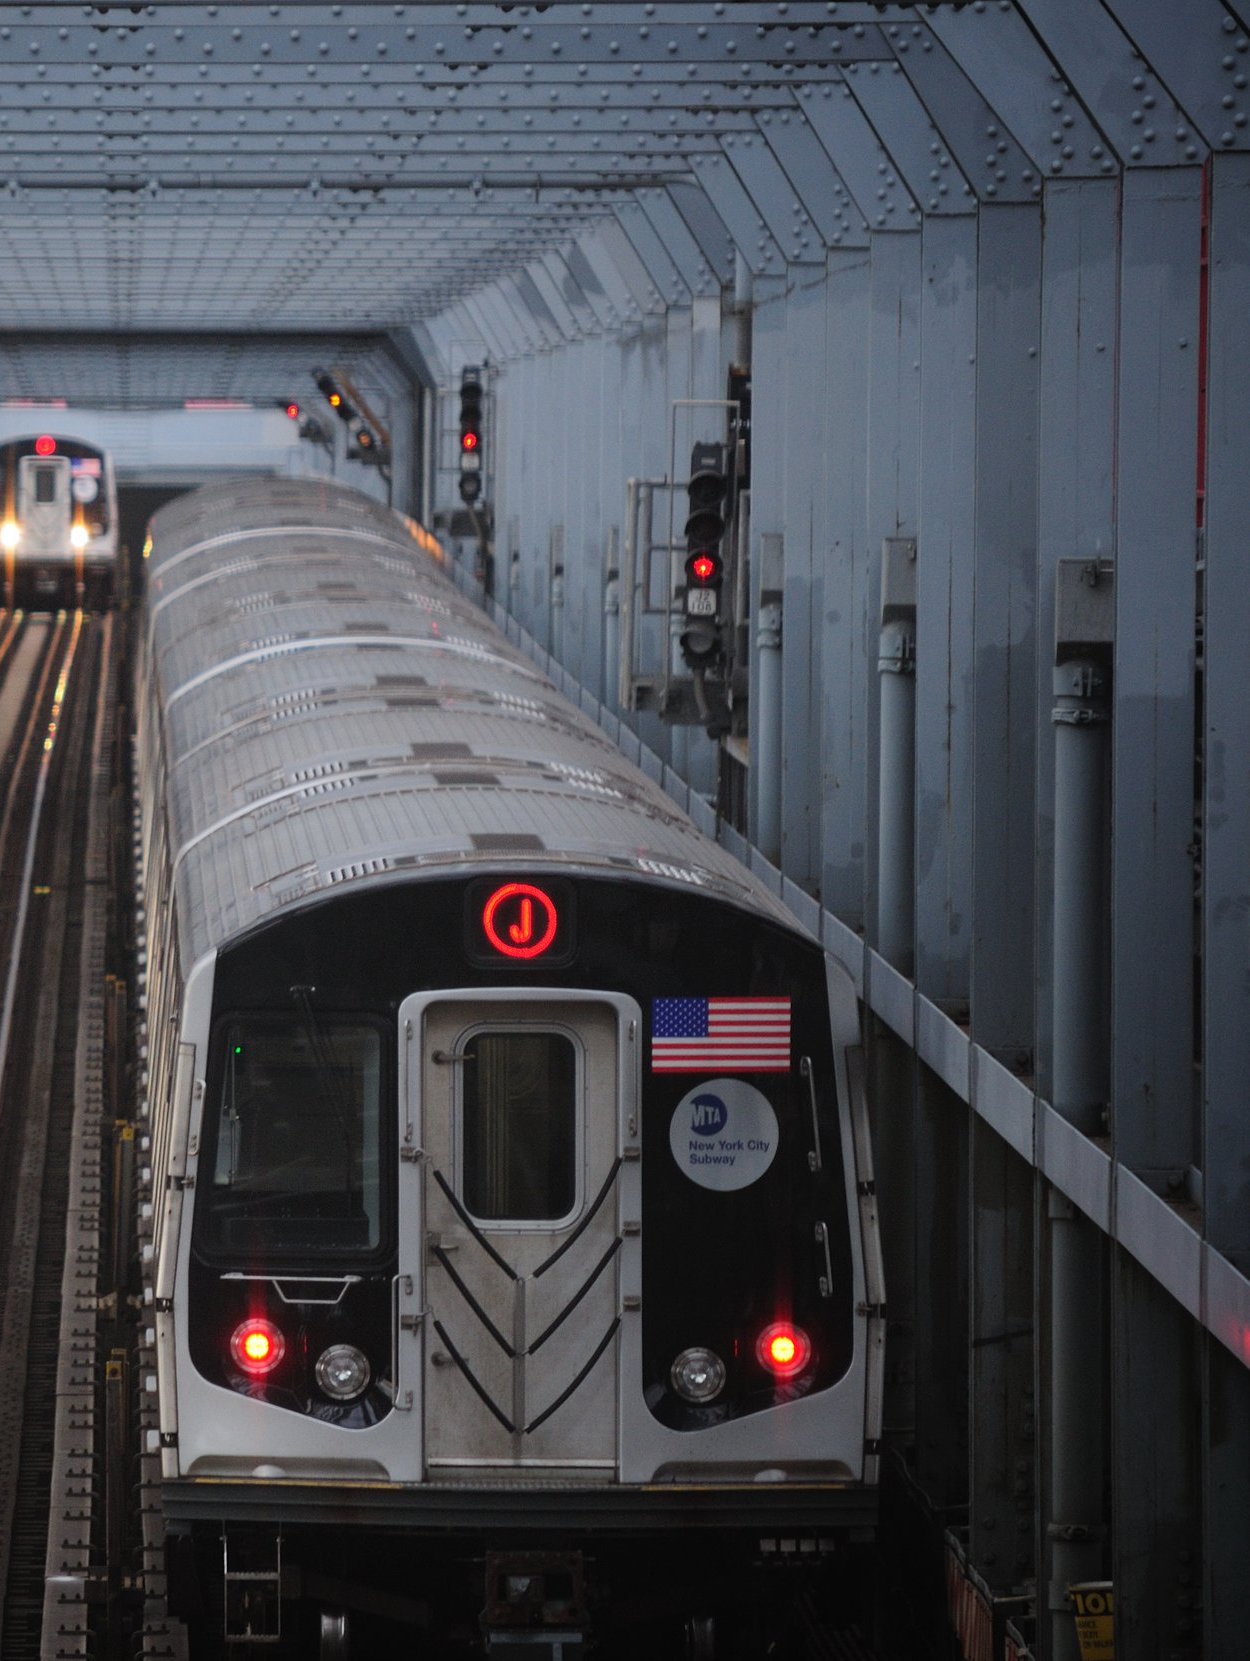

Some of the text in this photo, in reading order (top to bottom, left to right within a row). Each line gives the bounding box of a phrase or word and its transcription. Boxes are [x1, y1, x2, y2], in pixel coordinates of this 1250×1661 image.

[509, 898, 532, 943] J
[690, 1103, 721, 1128] MTA
[689, 1140, 770, 1153] New York City
[689, 1154, 736, 1167] Subway
